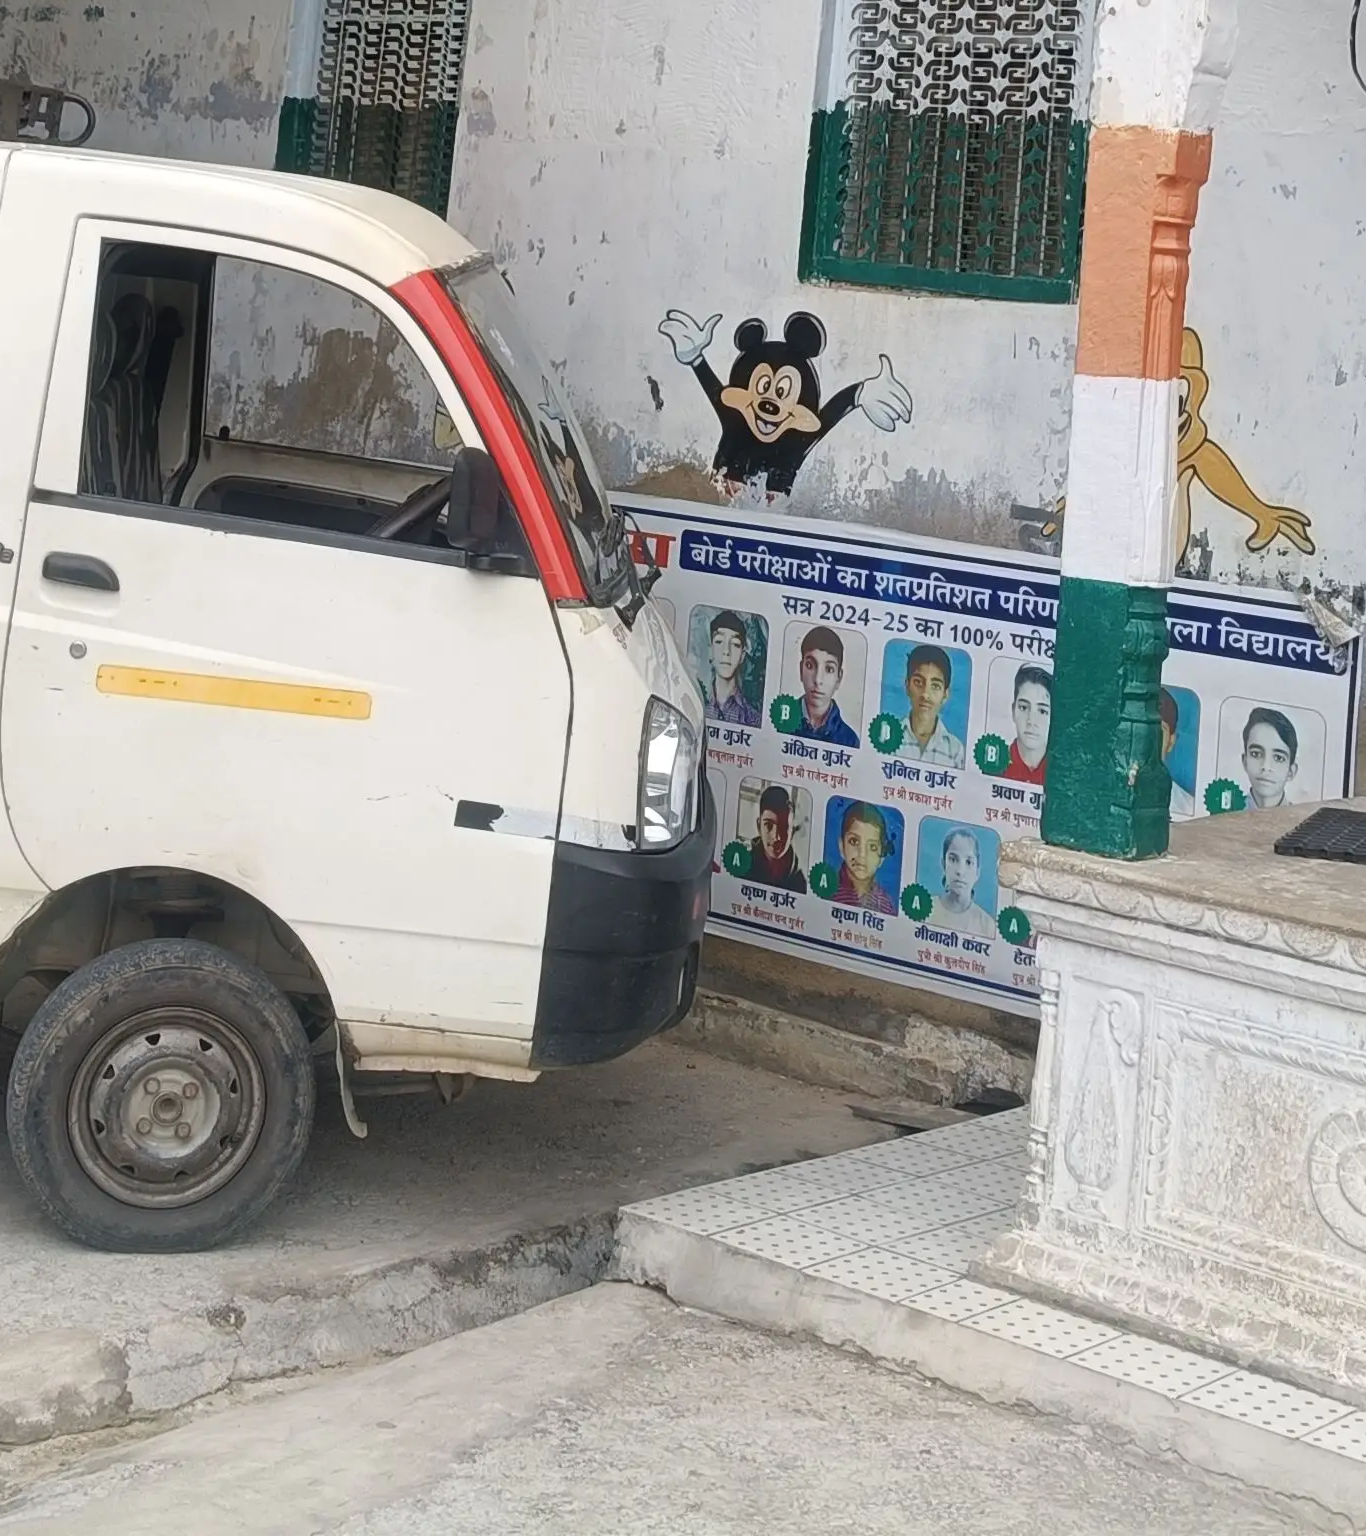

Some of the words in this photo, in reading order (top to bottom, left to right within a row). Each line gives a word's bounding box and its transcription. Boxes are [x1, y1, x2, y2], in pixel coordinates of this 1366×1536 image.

[690, 536, 733, 569] बोर्ड
[737, 545, 833, 584] परीक्षाओं
[835, 563, 869, 590] का
[873, 572, 992, 611] शतप्रतिशत
[997, 585, 1059, 621] परिण
[1165, 617, 1212, 646] ला
[782, 595, 814, 616] सत्र
[819, 601, 909, 633] 2024-25
[914, 615, 944, 639] का
[950, 624, 1004, 651] 100%
[1010, 629, 1056, 658] परीक्ष
[781, 704, 790, 721] B
[723, 729, 753, 746] गुर्जर
[781, 738, 818, 760] अंकित
[821, 748, 853, 768] गुर्जर
[781, 764, 794, 778] पुत्र
[795, 764, 805, 778] श्री
[806, 768, 829, 784] राजेन्द्र
[830, 772, 849, 789] गुर्जर
[881, 760, 921, 781] सुनिल
[924, 770, 958, 789] गुर्जर
[883, 786, 895, 800] पुत्र
[897, 785, 906, 800] श्री
[908, 791, 932, 805] प्रकाश
[934, 795, 953, 811] गुर्जर
[991, 783, 1026, 803] श्रवण
[1029, 791, 1043, 810] गु
[985, 807, 999, 822] पुत्र
[1001, 807, 1011, 822] श्री
[732, 852, 741, 867] A
[819, 873, 828, 889] A
[740, 884, 767, 901] कृष्ण
[770, 891, 797, 909] गुर्जर
[911, 895, 921, 911] A
[831, 906, 859, 924] कृष्ण
[862, 910, 885, 932] सिंह
[1008, 918, 1019, 934] A
[914, 925, 959, 949] मीनाक्षी
[962, 936, 992, 957] कंवर
[1014, 948, 1036, 967] हेत
